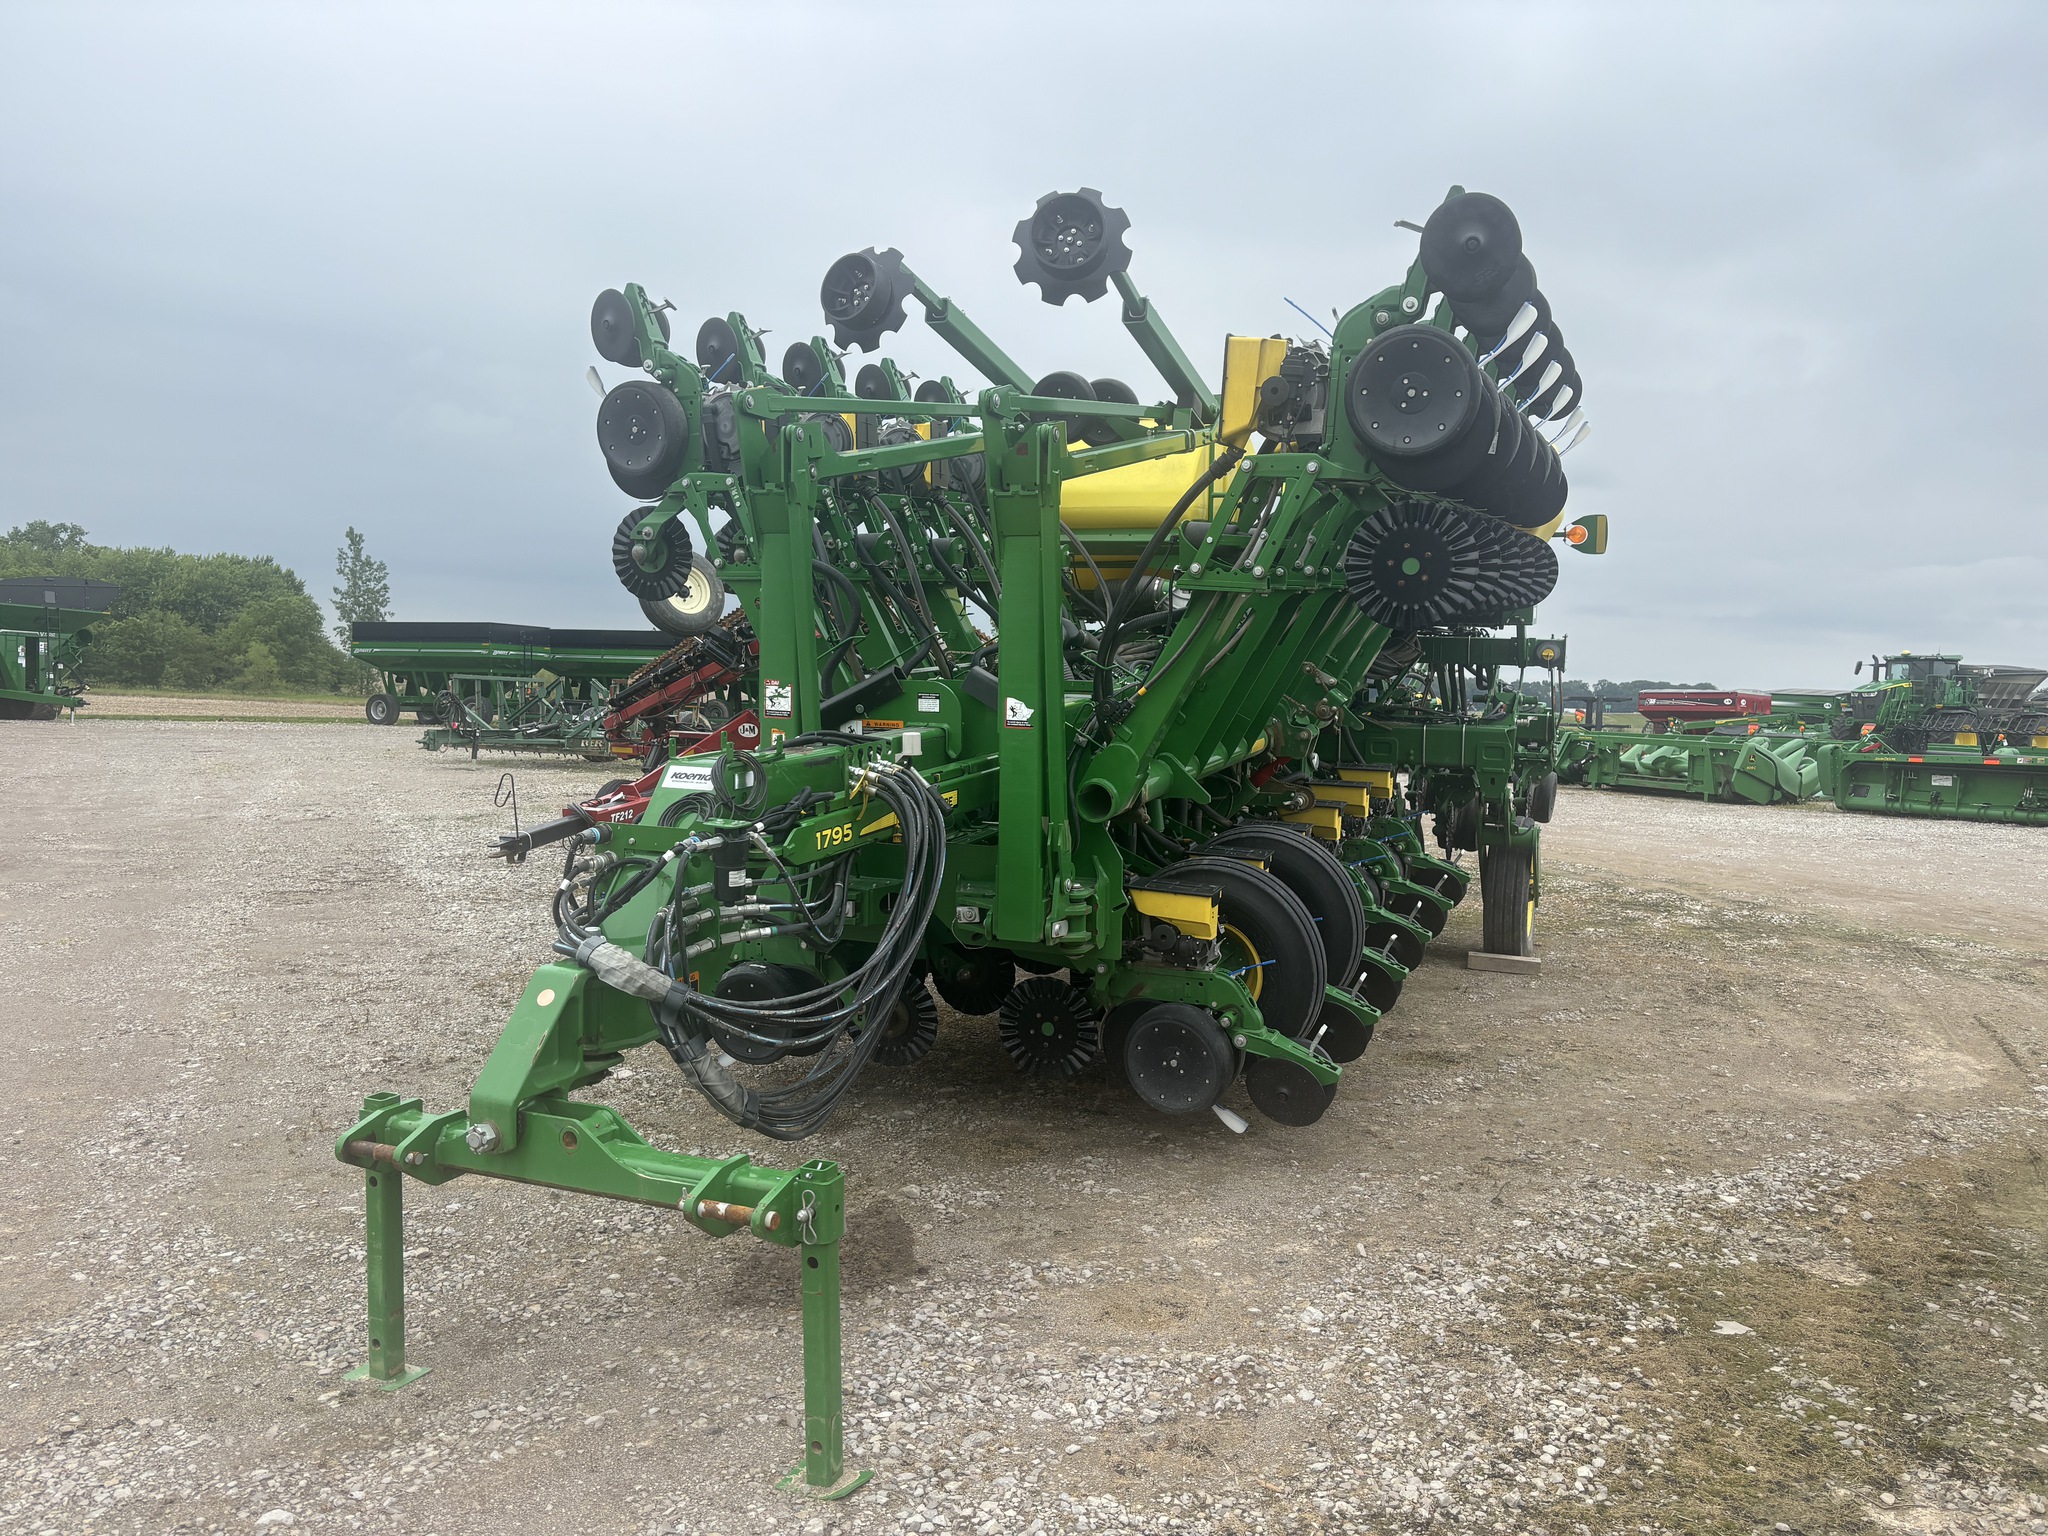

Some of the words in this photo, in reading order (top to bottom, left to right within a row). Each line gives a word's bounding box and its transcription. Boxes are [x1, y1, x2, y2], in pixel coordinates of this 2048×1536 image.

[740, 725, 756, 735] J&M
[611, 809, 634, 823] TF212
[815, 822, 853, 850] 1795
